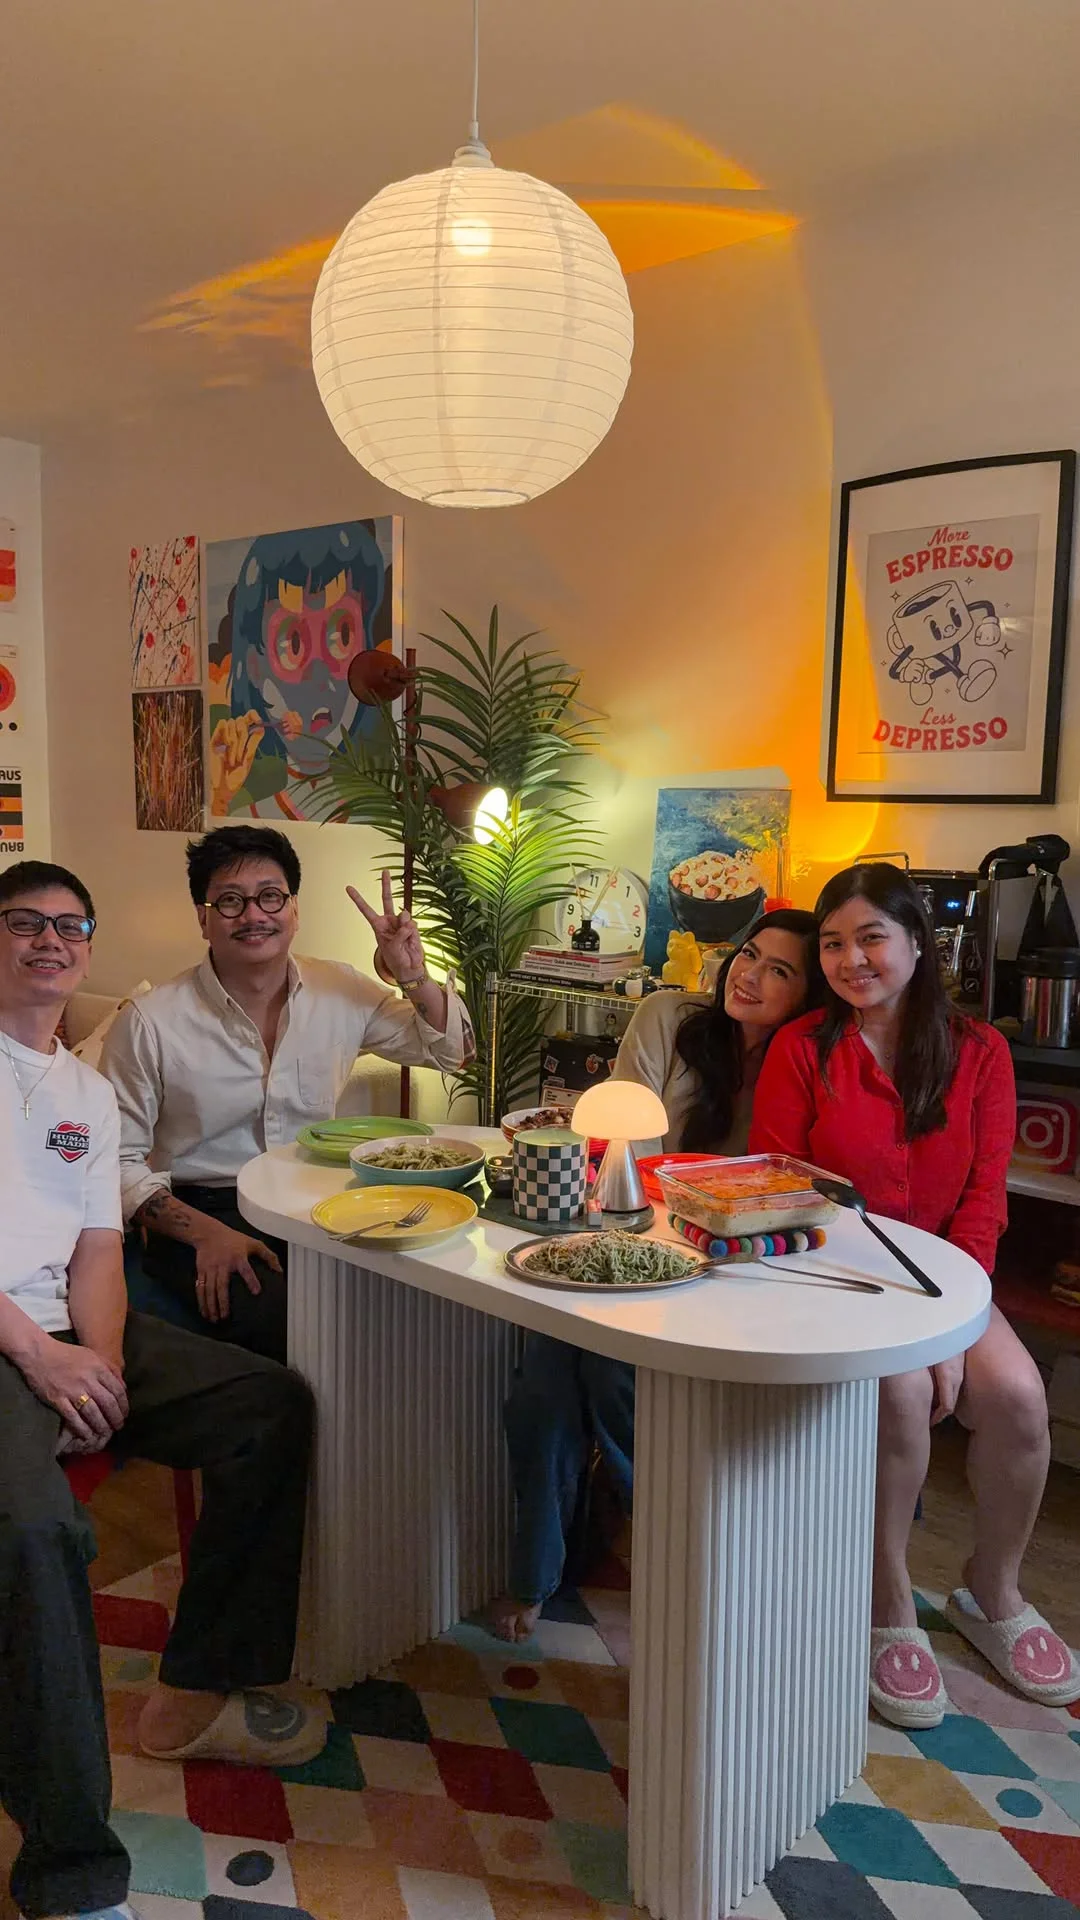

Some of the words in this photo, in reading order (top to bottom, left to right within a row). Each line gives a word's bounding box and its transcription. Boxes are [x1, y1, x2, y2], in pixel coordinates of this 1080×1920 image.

[927, 527, 970, 546] More
[886, 545, 1014, 584] ESPRESSO
[920, 707, 956, 726] Less
[873, 717, 1008, 750] DEPRESSO
[590, 875, 599, 888] 11
[626, 886, 631, 898] 1
[567, 904, 574, 915] 9
[632, 905, 640, 917] 2
[568, 925, 575, 936] 8
[633, 926, 641, 938] 3
